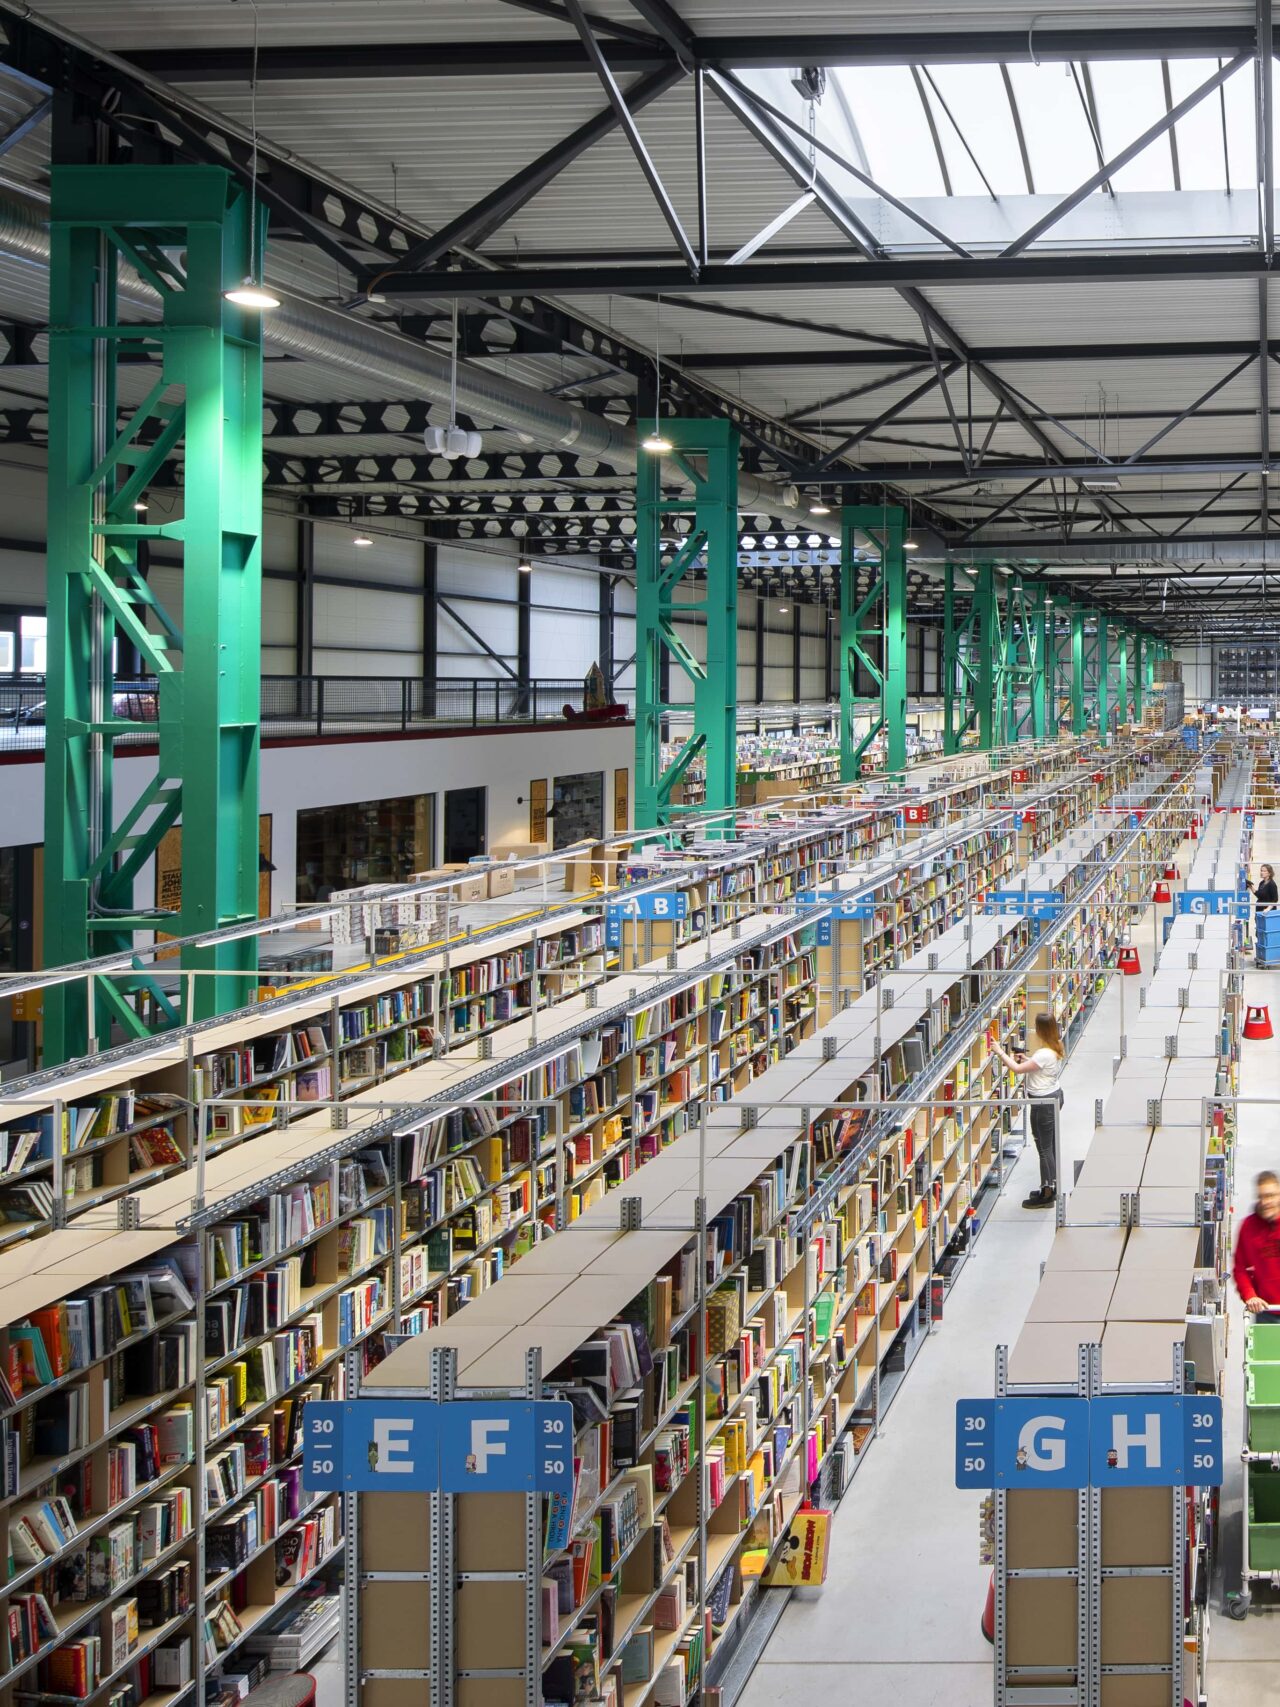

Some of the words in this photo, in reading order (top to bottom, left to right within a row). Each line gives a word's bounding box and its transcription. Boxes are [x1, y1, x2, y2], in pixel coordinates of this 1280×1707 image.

[909, 809, 918, 820] B
[624, 898, 642, 914] A
[654, 898, 669, 915] B
[840, 897, 858, 914] D
[1005, 898, 1018, 914] E
[1032, 898, 1045, 915] F
[1190, 897, 1205, 914] G
[1217, 897, 1232, 913] H
[312, 1419, 334, 1434] 30
[543, 1419, 564, 1434] 30
[964, 1416, 986, 1431] 30
[1192, 1414, 1214, 1428] 30
[372, 1418, 414, 1473] E
[471, 1419, 510, 1474] F
[1017, 1415, 1066, 1472] G
[1112, 1413, 1161, 1468] H
[312, 1460, 334, 1474] 50
[544, 1460, 564, 1474] 50
[964, 1458, 986, 1472] 50
[1193, 1454, 1214, 1469] 50
